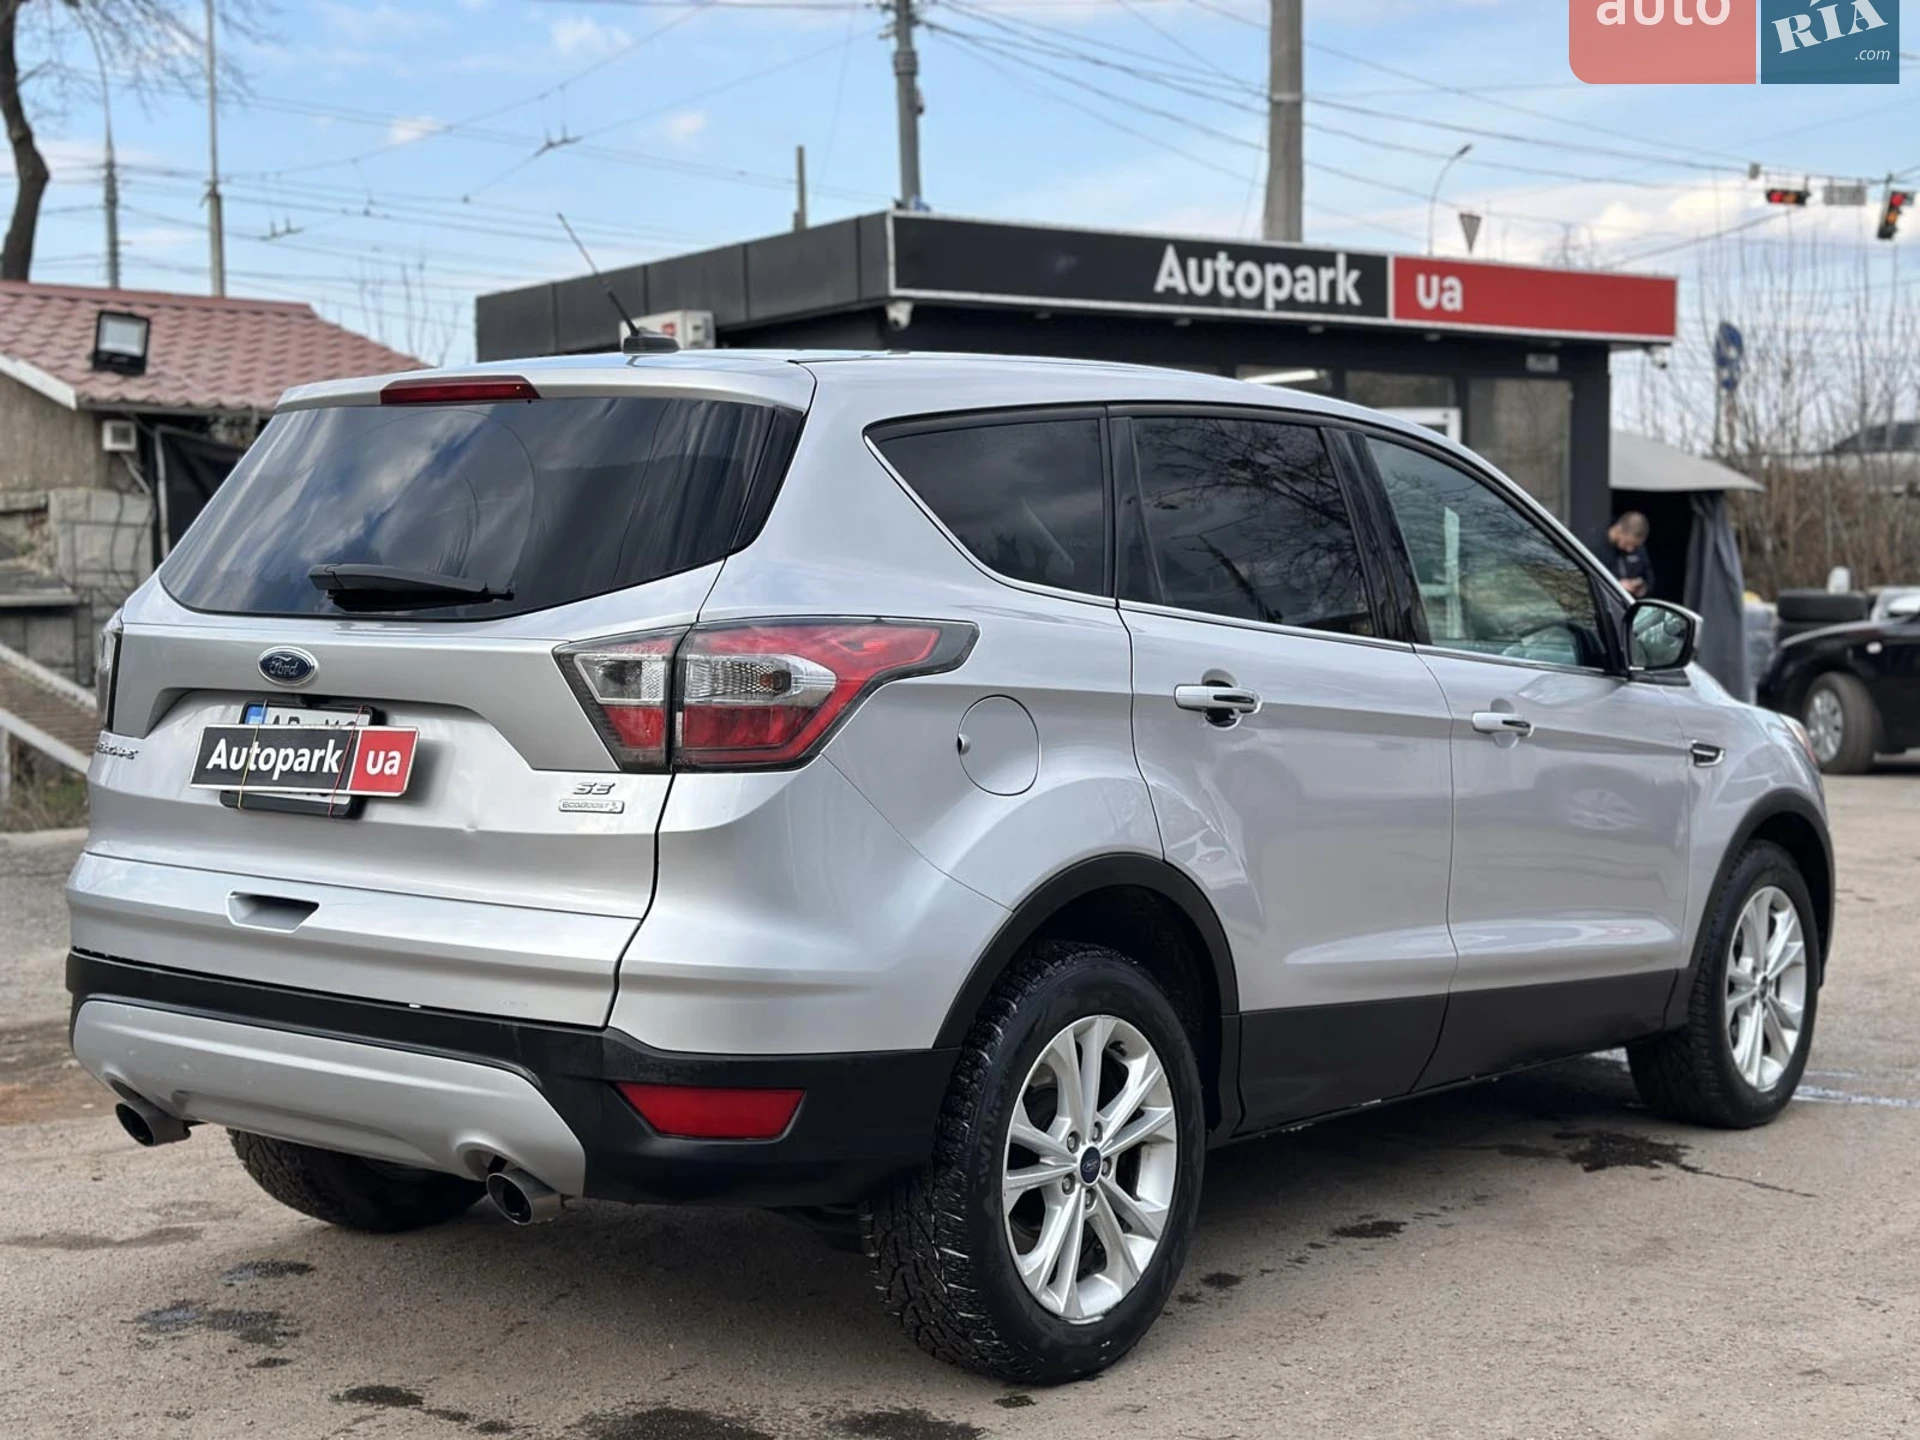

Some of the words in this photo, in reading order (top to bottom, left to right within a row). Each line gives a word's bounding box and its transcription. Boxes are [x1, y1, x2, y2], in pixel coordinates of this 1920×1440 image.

[1153, 243, 1362, 312] Autopark
[1416, 273, 1463, 312] ua
[269, 656, 300, 676] Ford
[206, 738, 344, 781] Autopark
[366, 749, 402, 776] ua
[572, 782, 616, 795] SE
